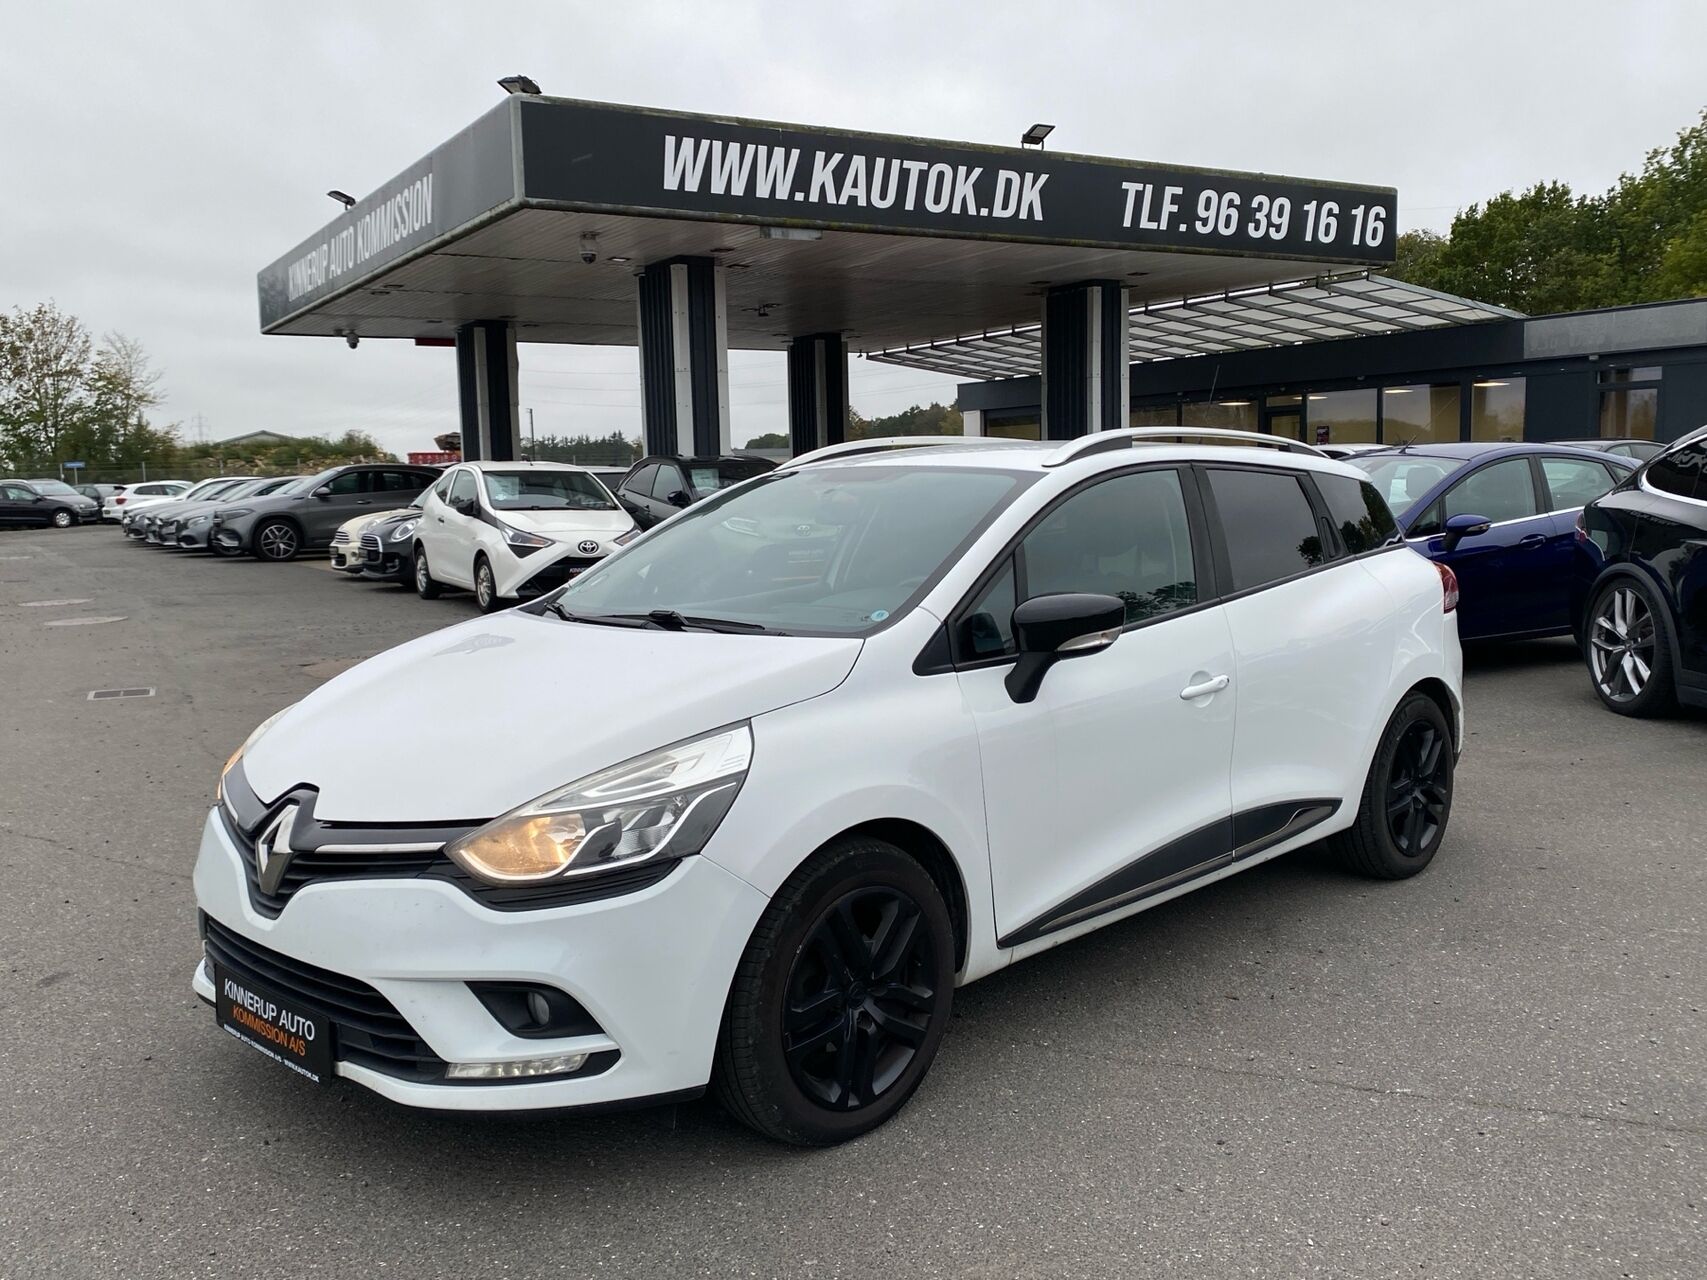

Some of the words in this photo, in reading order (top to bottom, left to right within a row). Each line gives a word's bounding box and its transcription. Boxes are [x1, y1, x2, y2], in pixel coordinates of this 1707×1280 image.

[663, 135, 1050, 221] WWW.KAUTOK.DK
[288, 243, 328, 302] KINNERUP
[329, 226, 354, 279] AUTO
[356, 173, 432, 264] KOMMISSION
[1121, 182, 1187, 232] TLF.
[1195, 189, 1241, 236] 96
[1248, 194, 1291, 240] 39
[1303, 200, 1339, 244] 16
[1351, 204, 1386, 247] 16
[224, 978, 277, 1021] KINNERUP
[279, 1009, 315, 1040] AUTO
[232, 1005, 287, 1047] KOMMISSION
[289, 1036, 306, 1057] A/S
